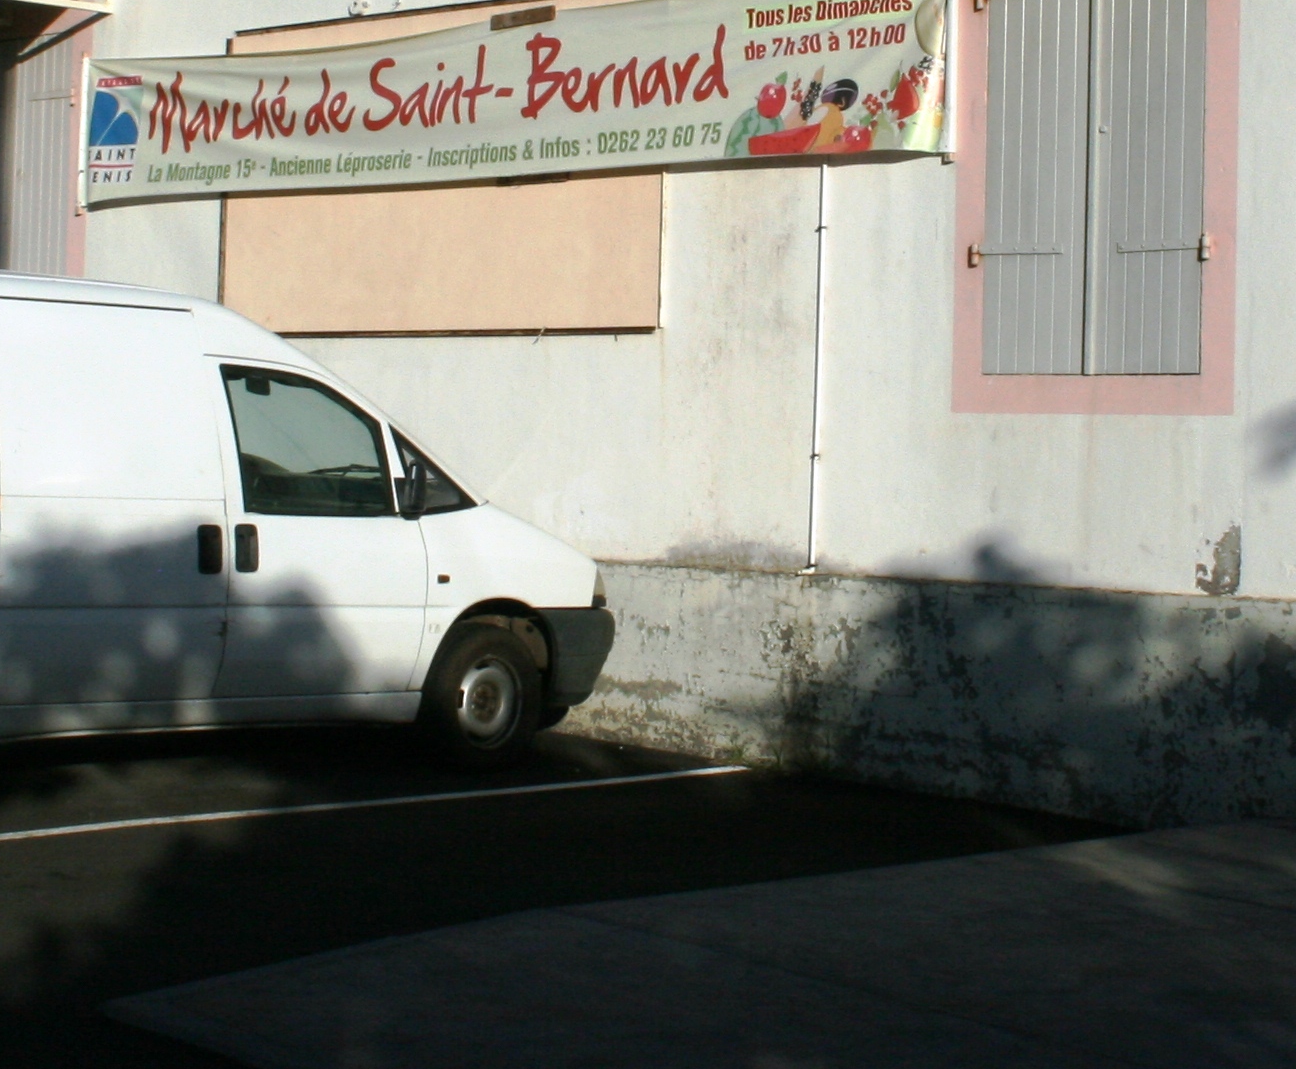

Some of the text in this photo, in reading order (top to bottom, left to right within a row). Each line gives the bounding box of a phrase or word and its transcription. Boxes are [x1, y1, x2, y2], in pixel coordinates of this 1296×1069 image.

[746, 8, 784, 29] Tous
[788, 4, 812, 24] les
[744, 41, 767, 61] de
[828, 31, 840, 52] à
[148, 24, 729, 154] Marché de Saint-Bernard
[147, 164, 163, 183] La
[166, 162, 231, 186] Montagne
[269, 155, 331, 177] Ancienne
[336, 149, 412, 177] Léproserie
[427, 141, 517, 170] Inscriptions
[522, 138, 534, 161] &
[540, 136, 580, 159] Infos
[597, 128, 641, 155] 0262
[645, 127, 668, 150] 23
[672, 125, 695, 148] 60
[701, 121, 722, 145] 75
